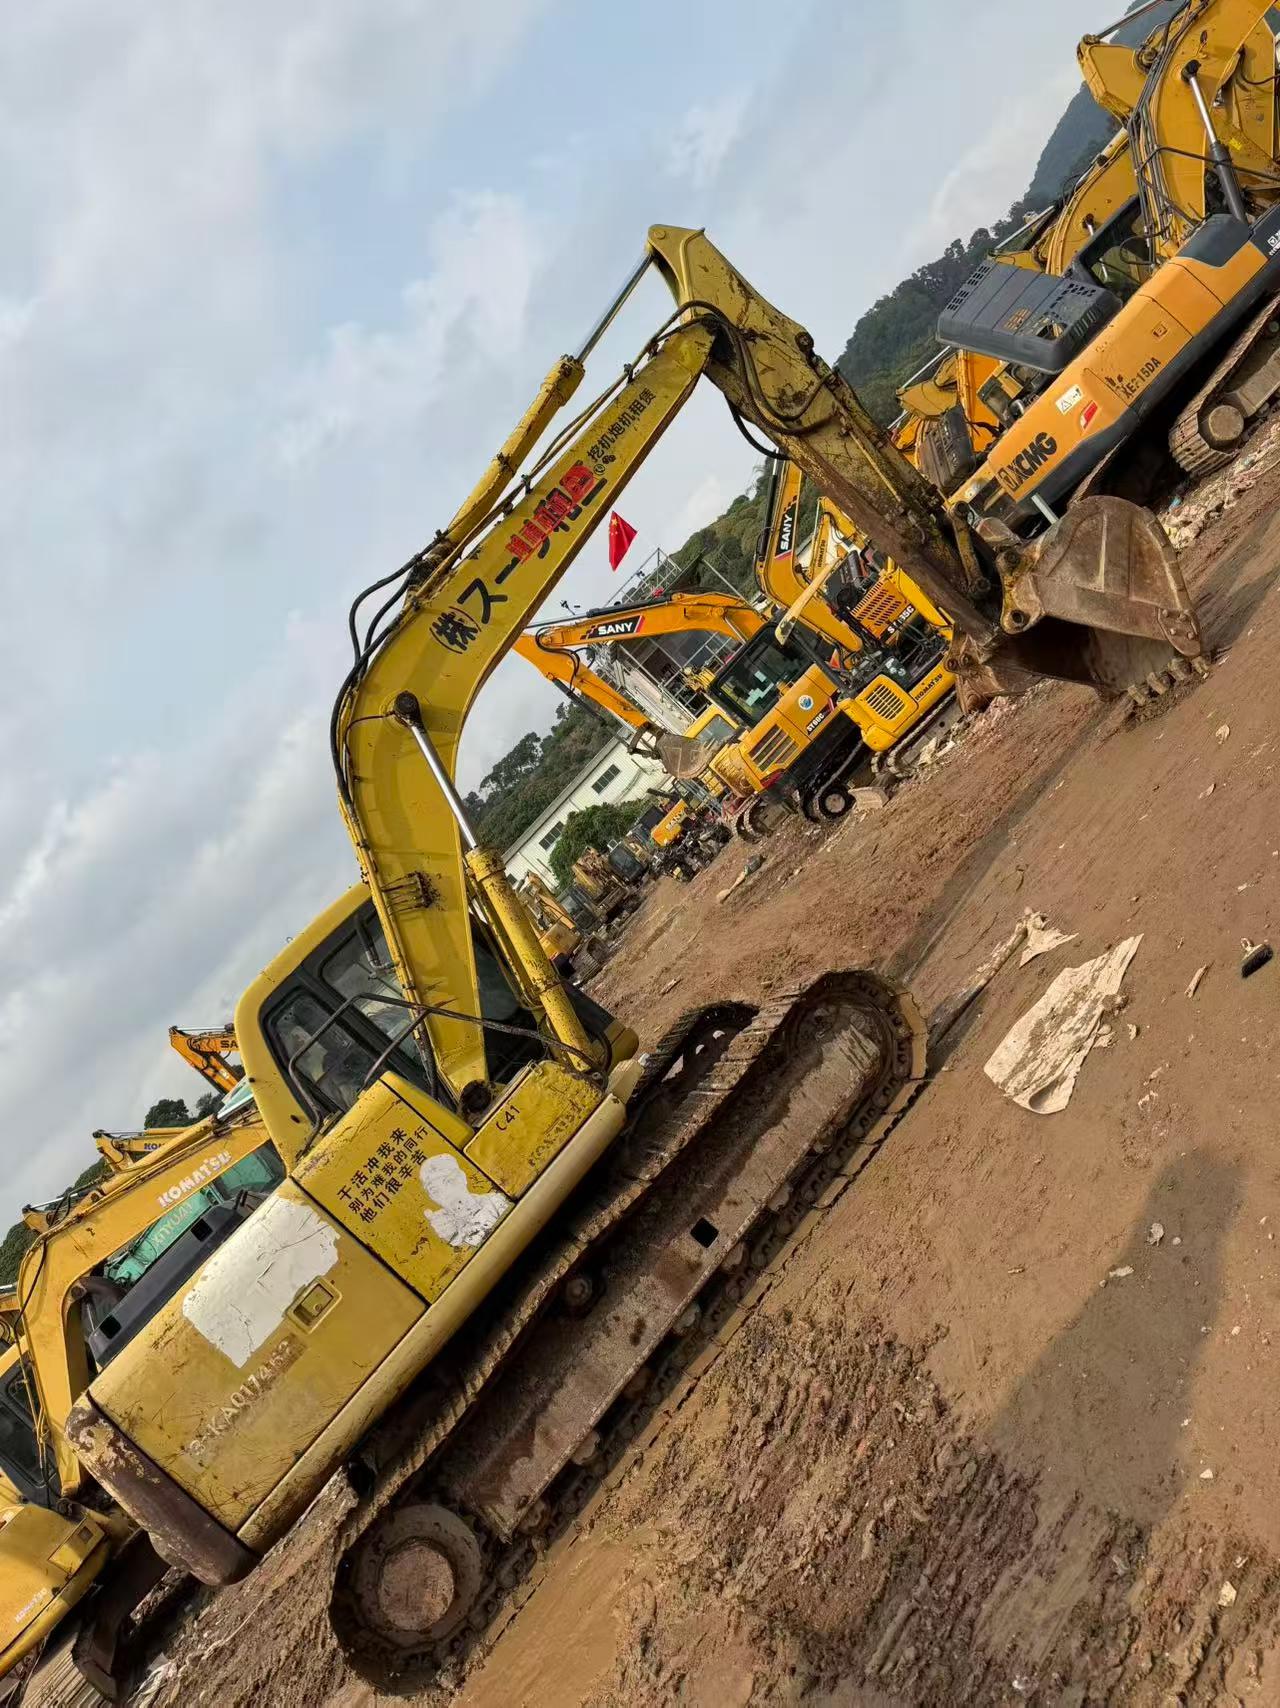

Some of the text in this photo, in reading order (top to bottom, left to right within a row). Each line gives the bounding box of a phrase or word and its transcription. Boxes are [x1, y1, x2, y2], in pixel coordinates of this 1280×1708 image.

[588, 388, 656, 462] 挖机炮机租赁
[1009, 431, 1058, 483] XCMG
[780, 514, 793, 550] SANY
[598, 622, 633, 634] SANY
[914, 672, 944, 702] KOMATSU
[220, 1039, 238, 1048] SA
[158, 1150, 232, 1209] KOMATSU
[336, 1127, 408, 1203] 干活冲我来
[348, 1125, 429, 1215] 别为难我的同行
[359, 1150, 428, 1225] 他们很辛苦
